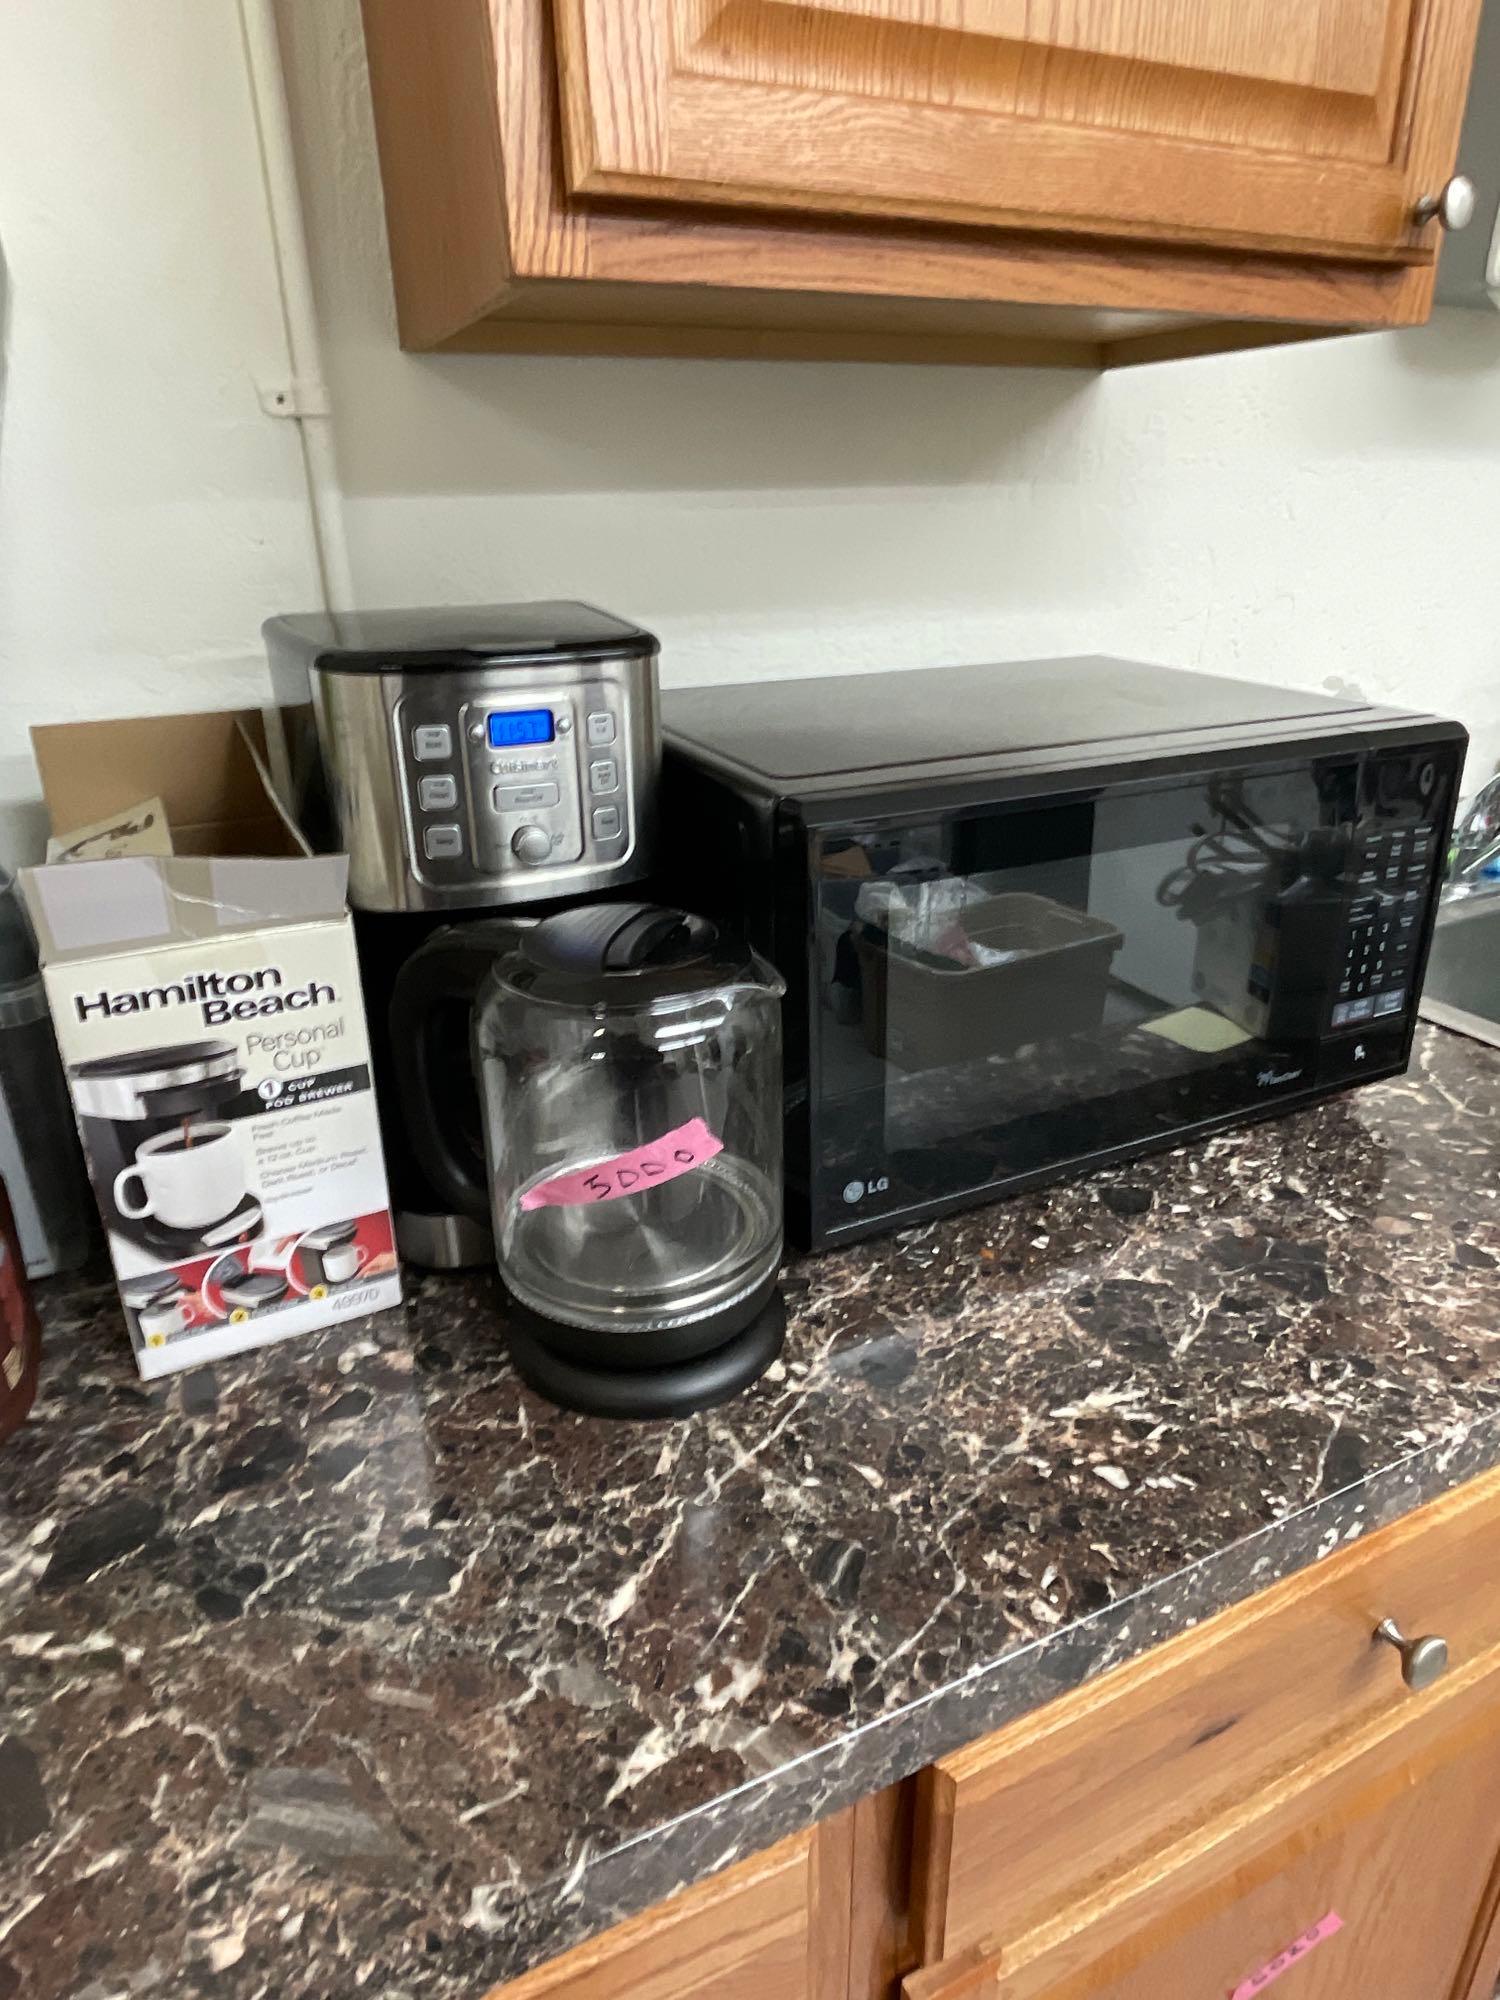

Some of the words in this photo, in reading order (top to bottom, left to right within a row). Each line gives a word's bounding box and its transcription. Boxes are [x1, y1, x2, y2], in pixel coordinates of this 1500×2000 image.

[74, 967, 282, 1023] Hamilton
[201, 981, 336, 1028] Beach
[246, 1016, 345, 1055] Personal
[273, 1049, 321, 1072] Cup
[298, 1080, 354, 1103] BREWER
[868, 1176, 889, 1194] LG
